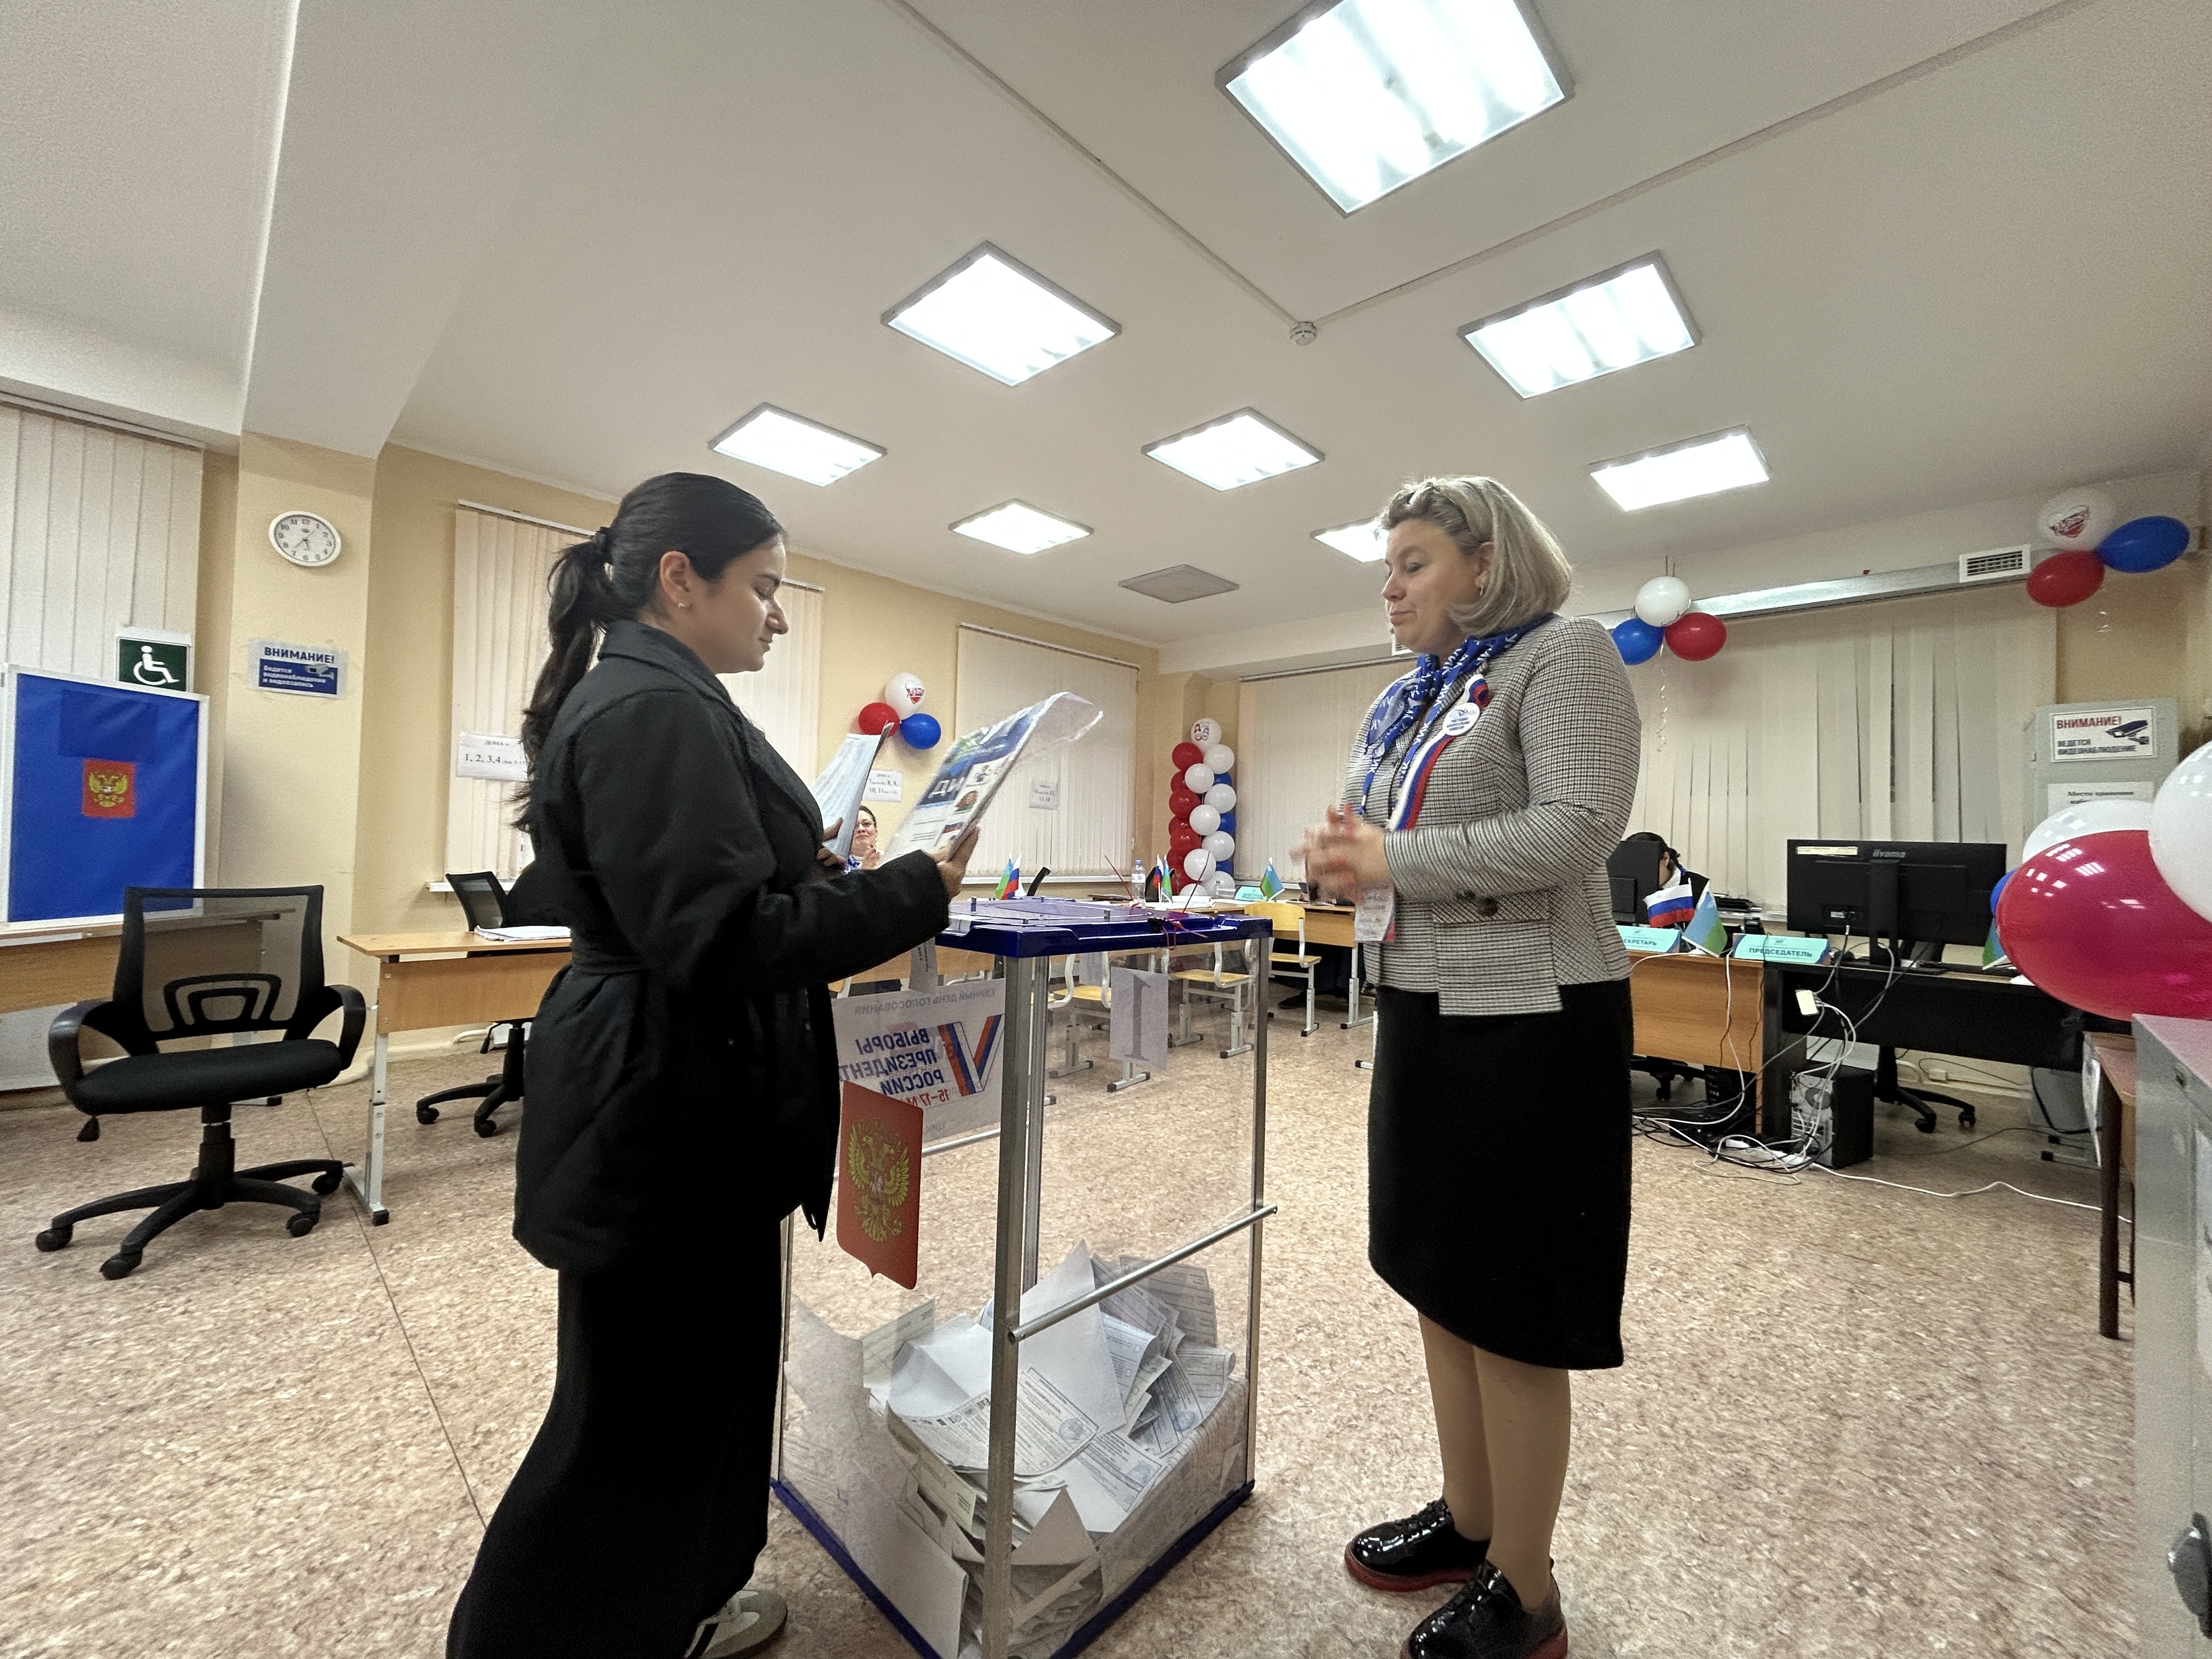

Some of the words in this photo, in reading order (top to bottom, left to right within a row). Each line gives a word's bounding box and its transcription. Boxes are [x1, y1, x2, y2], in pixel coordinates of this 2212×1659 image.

[264, 646, 335, 664] ВНИМАНИЕ!
[2056, 715, 2122, 730] ВНИМАНИЕ!
[2057, 739, 2091, 747] ВЕДЕТСЯ
[2057, 744, 2137, 755] ВИДЕОНАБЛЮДЕНИЕ
[1872, 849, 1906, 858] iiyama
[1622, 938, 1657, 946] ЕКРЕТАРЬ
[1749, 947, 1813, 957] ПРЕДСЕДАТЕЛЬ
